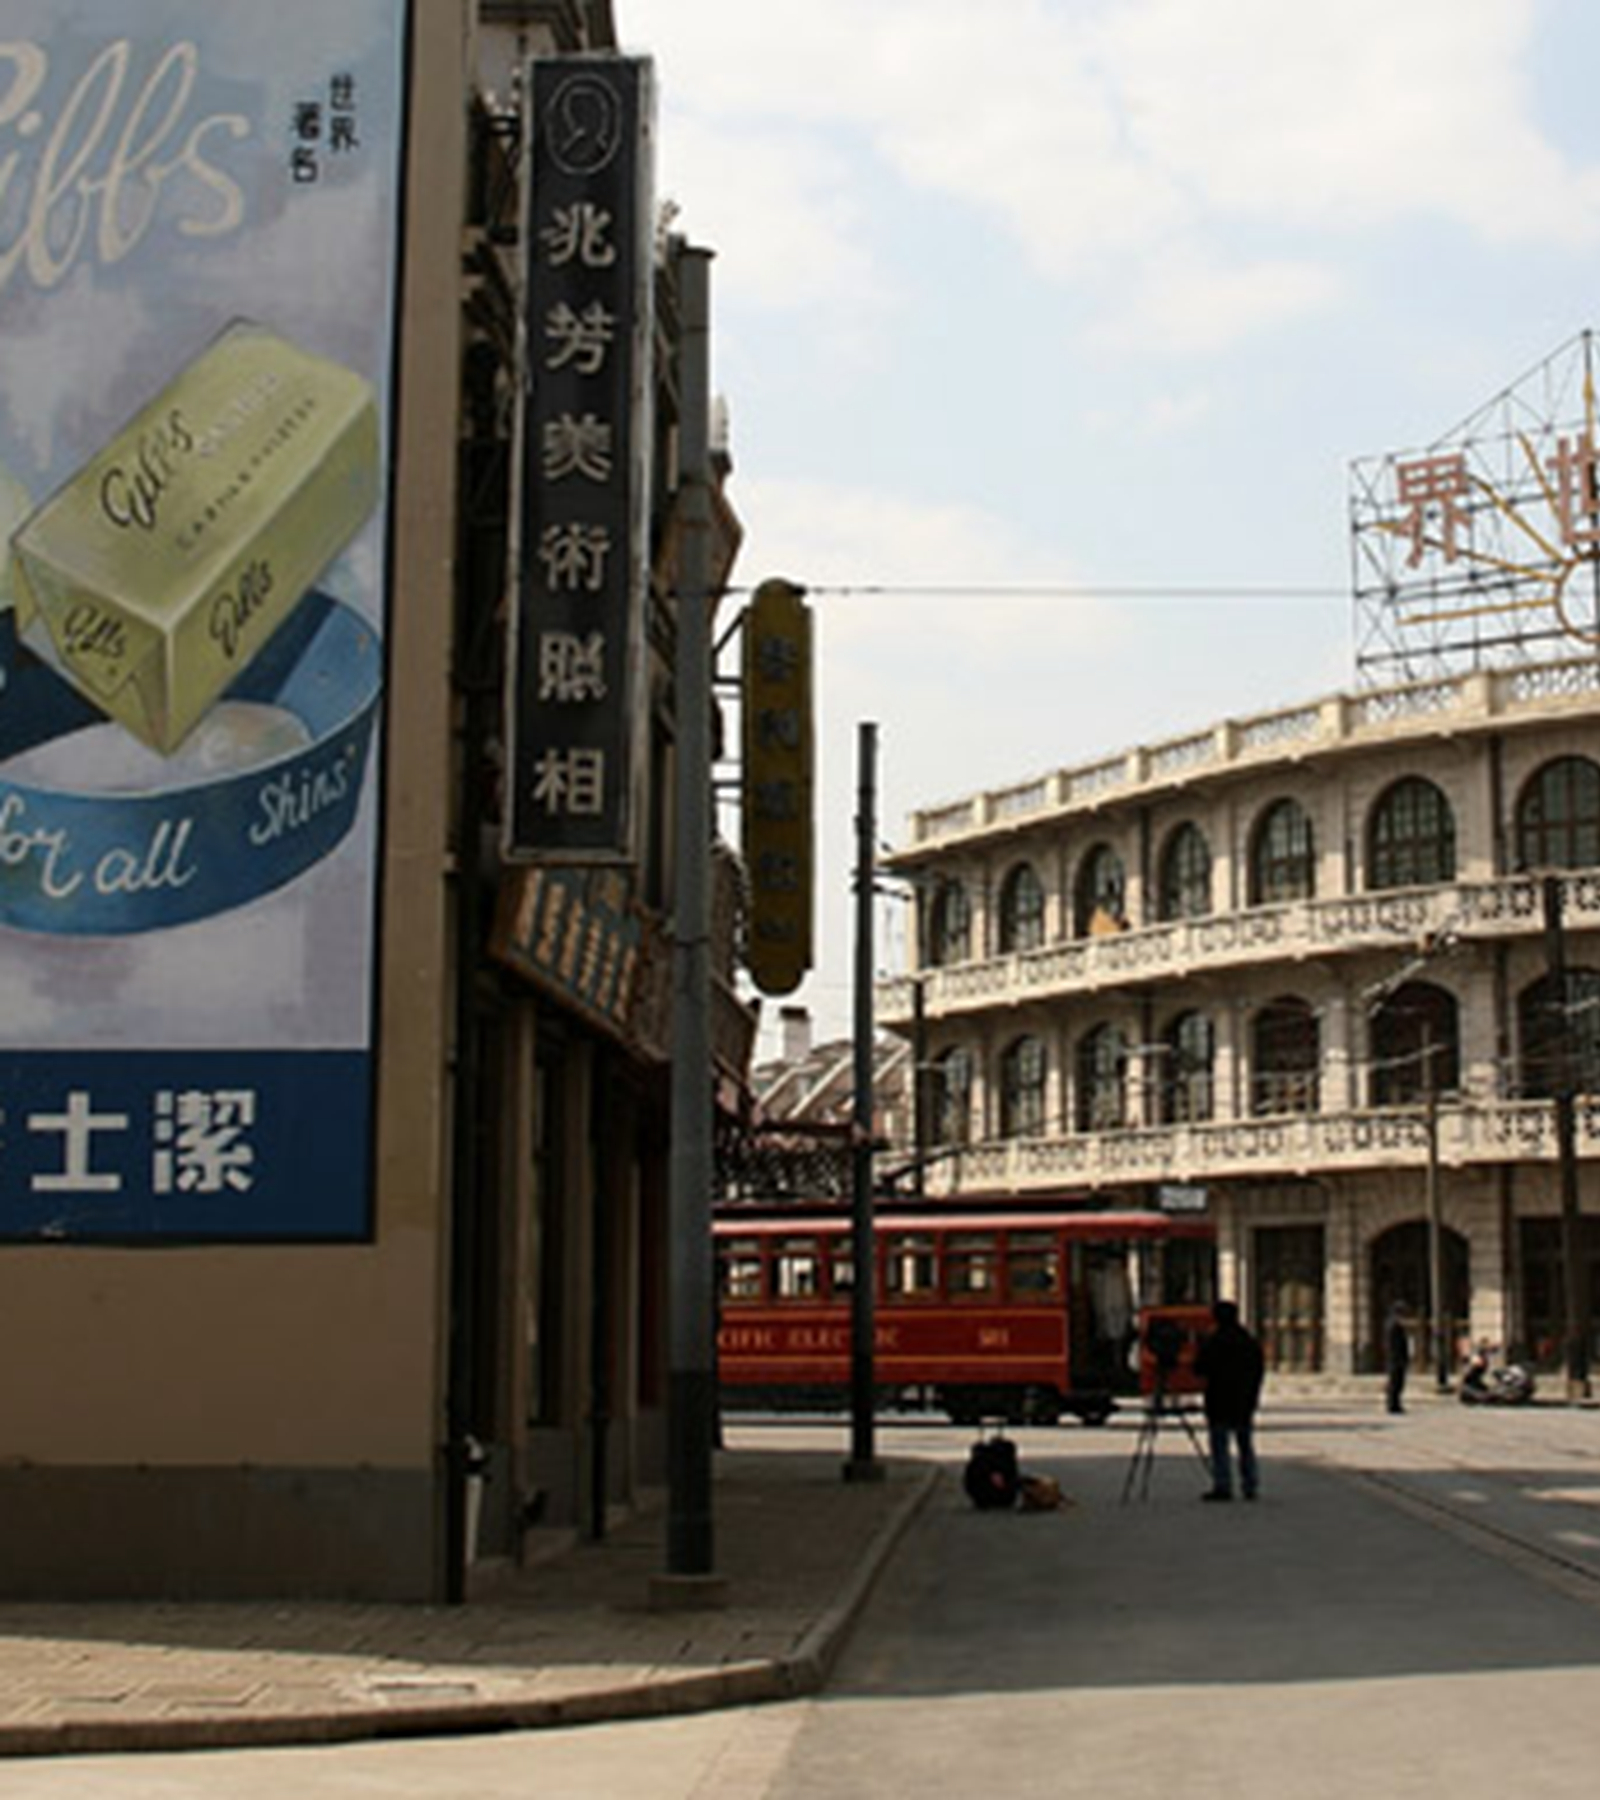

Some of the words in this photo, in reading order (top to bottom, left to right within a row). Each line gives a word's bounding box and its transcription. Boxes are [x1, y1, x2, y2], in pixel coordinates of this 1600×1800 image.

[329, 74, 360, 154] 世界
[94, 818, 197, 894] all
[716, 1327, 776, 1350] CIFIC
